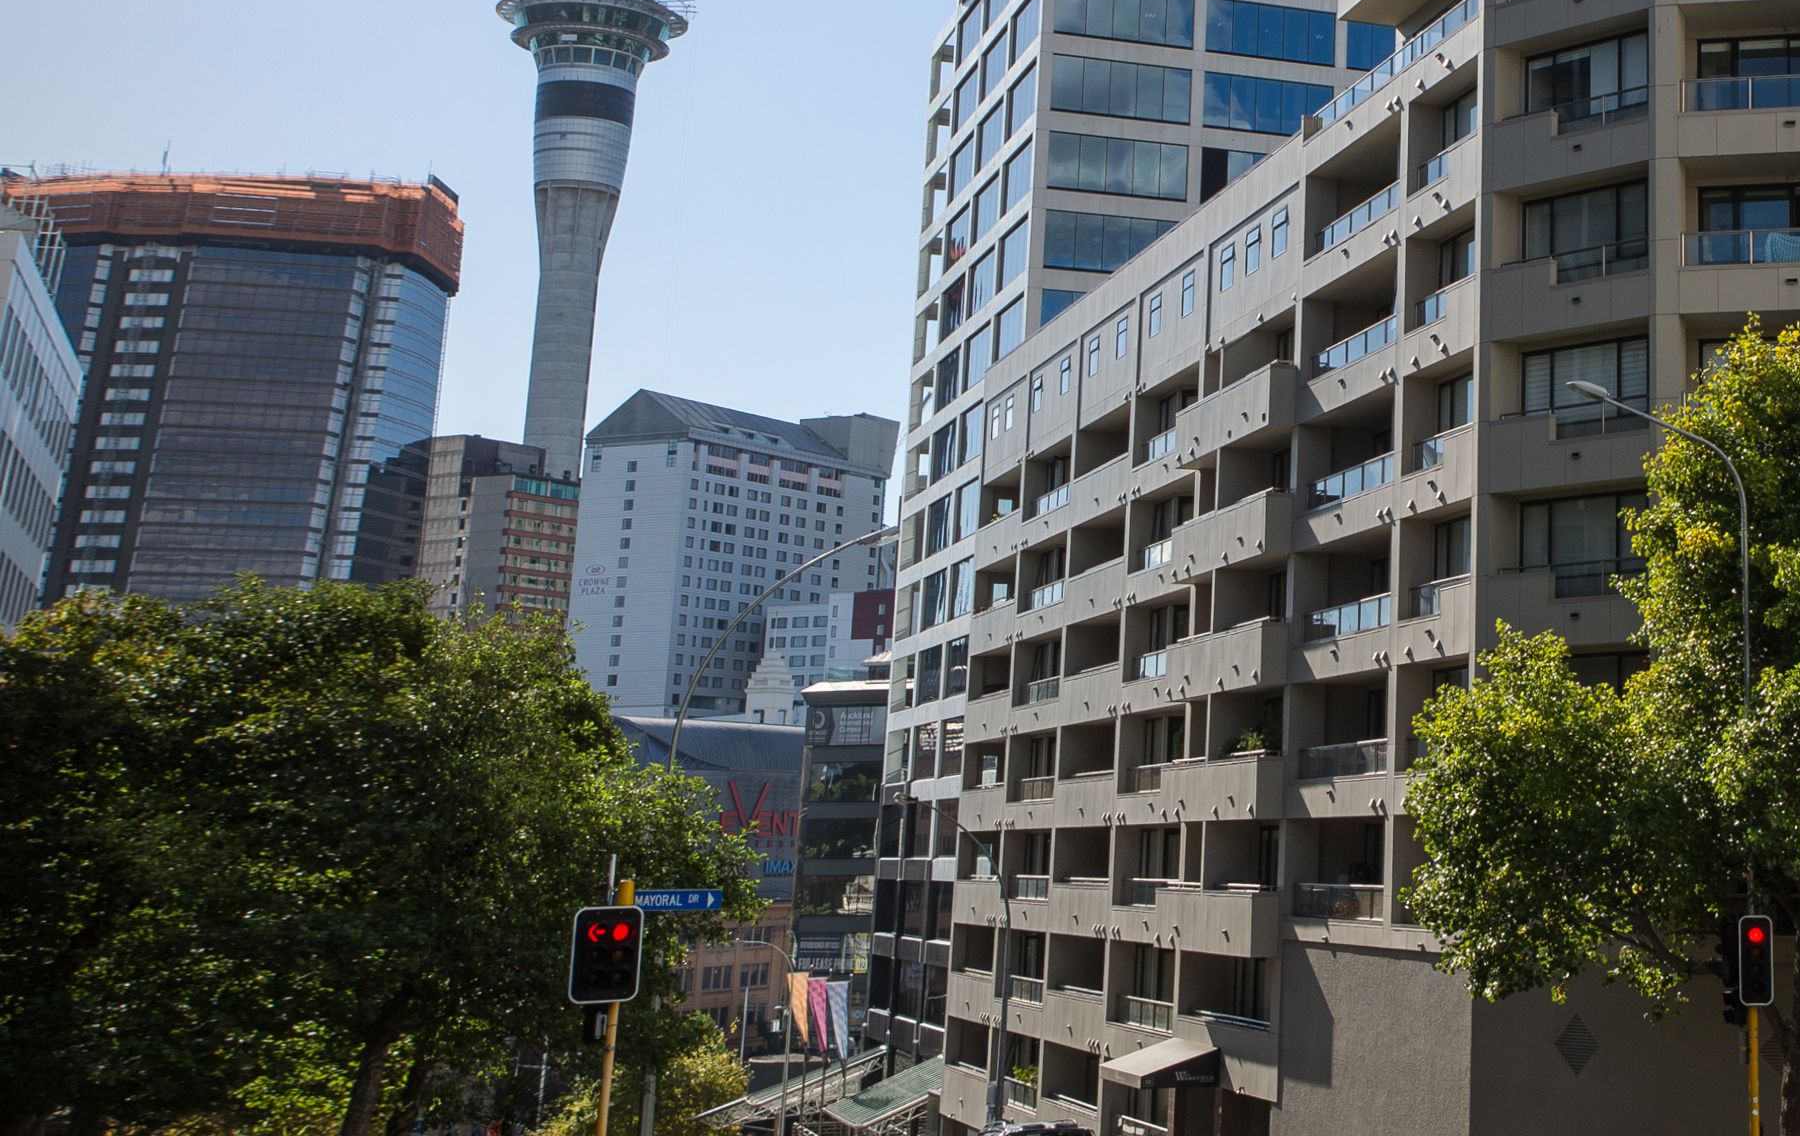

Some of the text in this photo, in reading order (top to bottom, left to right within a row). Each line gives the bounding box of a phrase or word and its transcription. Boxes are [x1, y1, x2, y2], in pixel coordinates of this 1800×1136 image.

[578, 577, 610, 587] CROWNE
[581, 587, 606, 595] PLAZA
[720, 779, 800, 838] EVENT
[765, 860, 797, 874] IMAX
[635, 893, 700, 906] MAYORAL DR
[798, 958, 811, 970] FOR
[812, 958, 833, 970] LEASE
